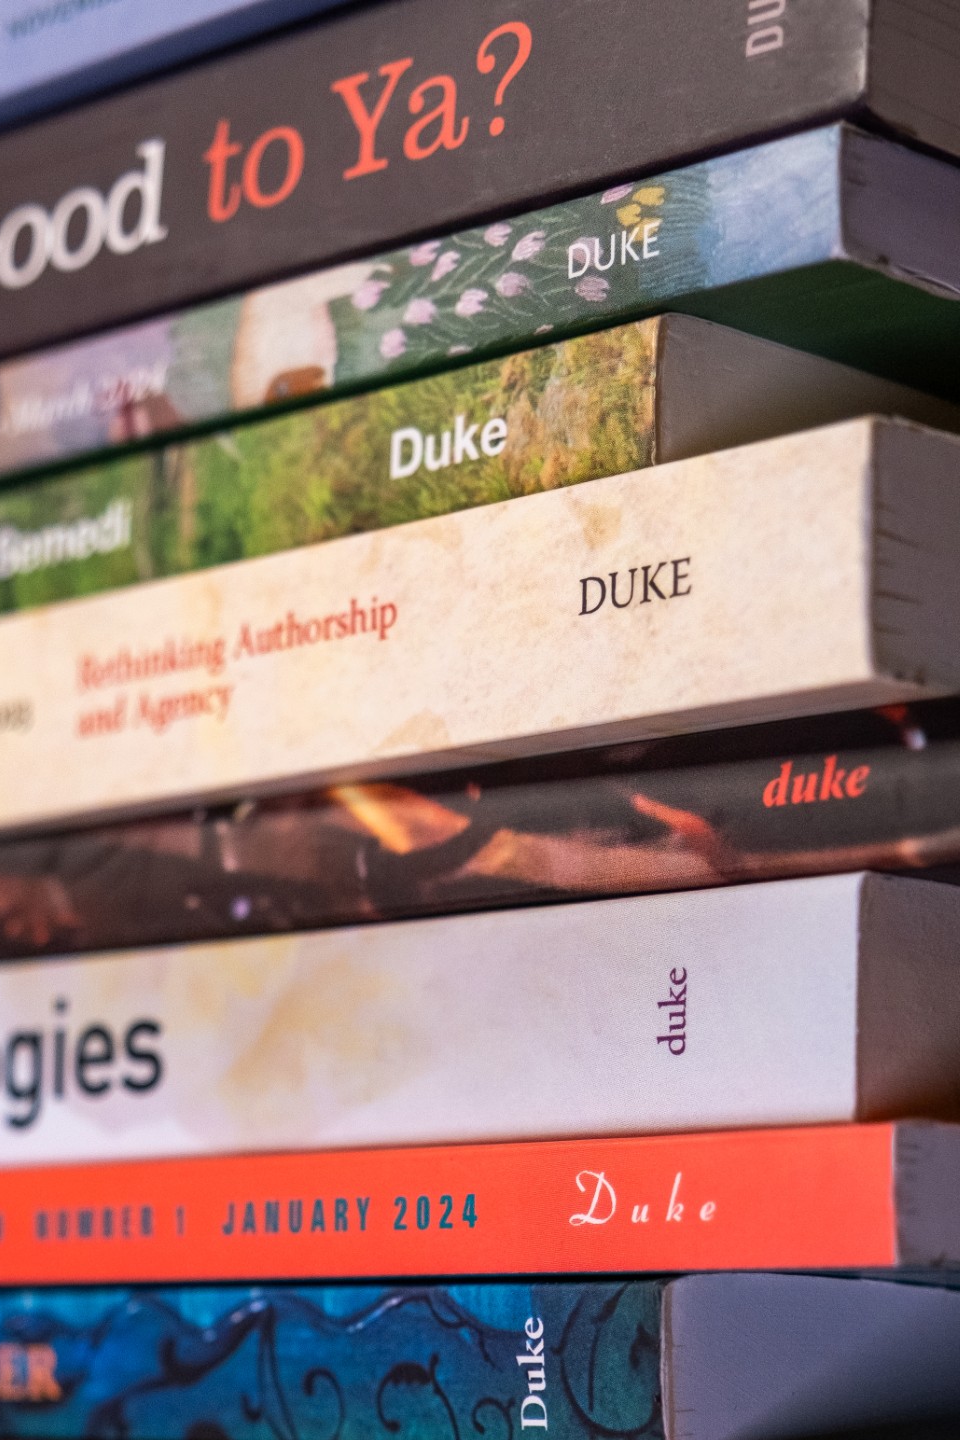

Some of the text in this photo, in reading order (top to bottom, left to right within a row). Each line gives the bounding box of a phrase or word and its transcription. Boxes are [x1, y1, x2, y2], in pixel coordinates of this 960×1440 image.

[746, 0, 786, 57] DU
[202, 117, 305, 223] to
[331, 21, 533, 182] Ya?
[567, 219, 661, 279] DUKE
[389, 414, 508, 480] Duke
[578, 556, 693, 617] DUKE
[76, 596, 398, 694] Rethinking Authorship
[140, 680, 234, 735] Agency
[762, 755, 871, 808] duke
[657, 965, 688, 1055] duke
[222, 1196, 372, 1236] JANUARY
[393, 1193, 480, 1231] 2024
[568, 1169, 718, 1228] Duke
[520, 1316, 549, 1431] Duke
